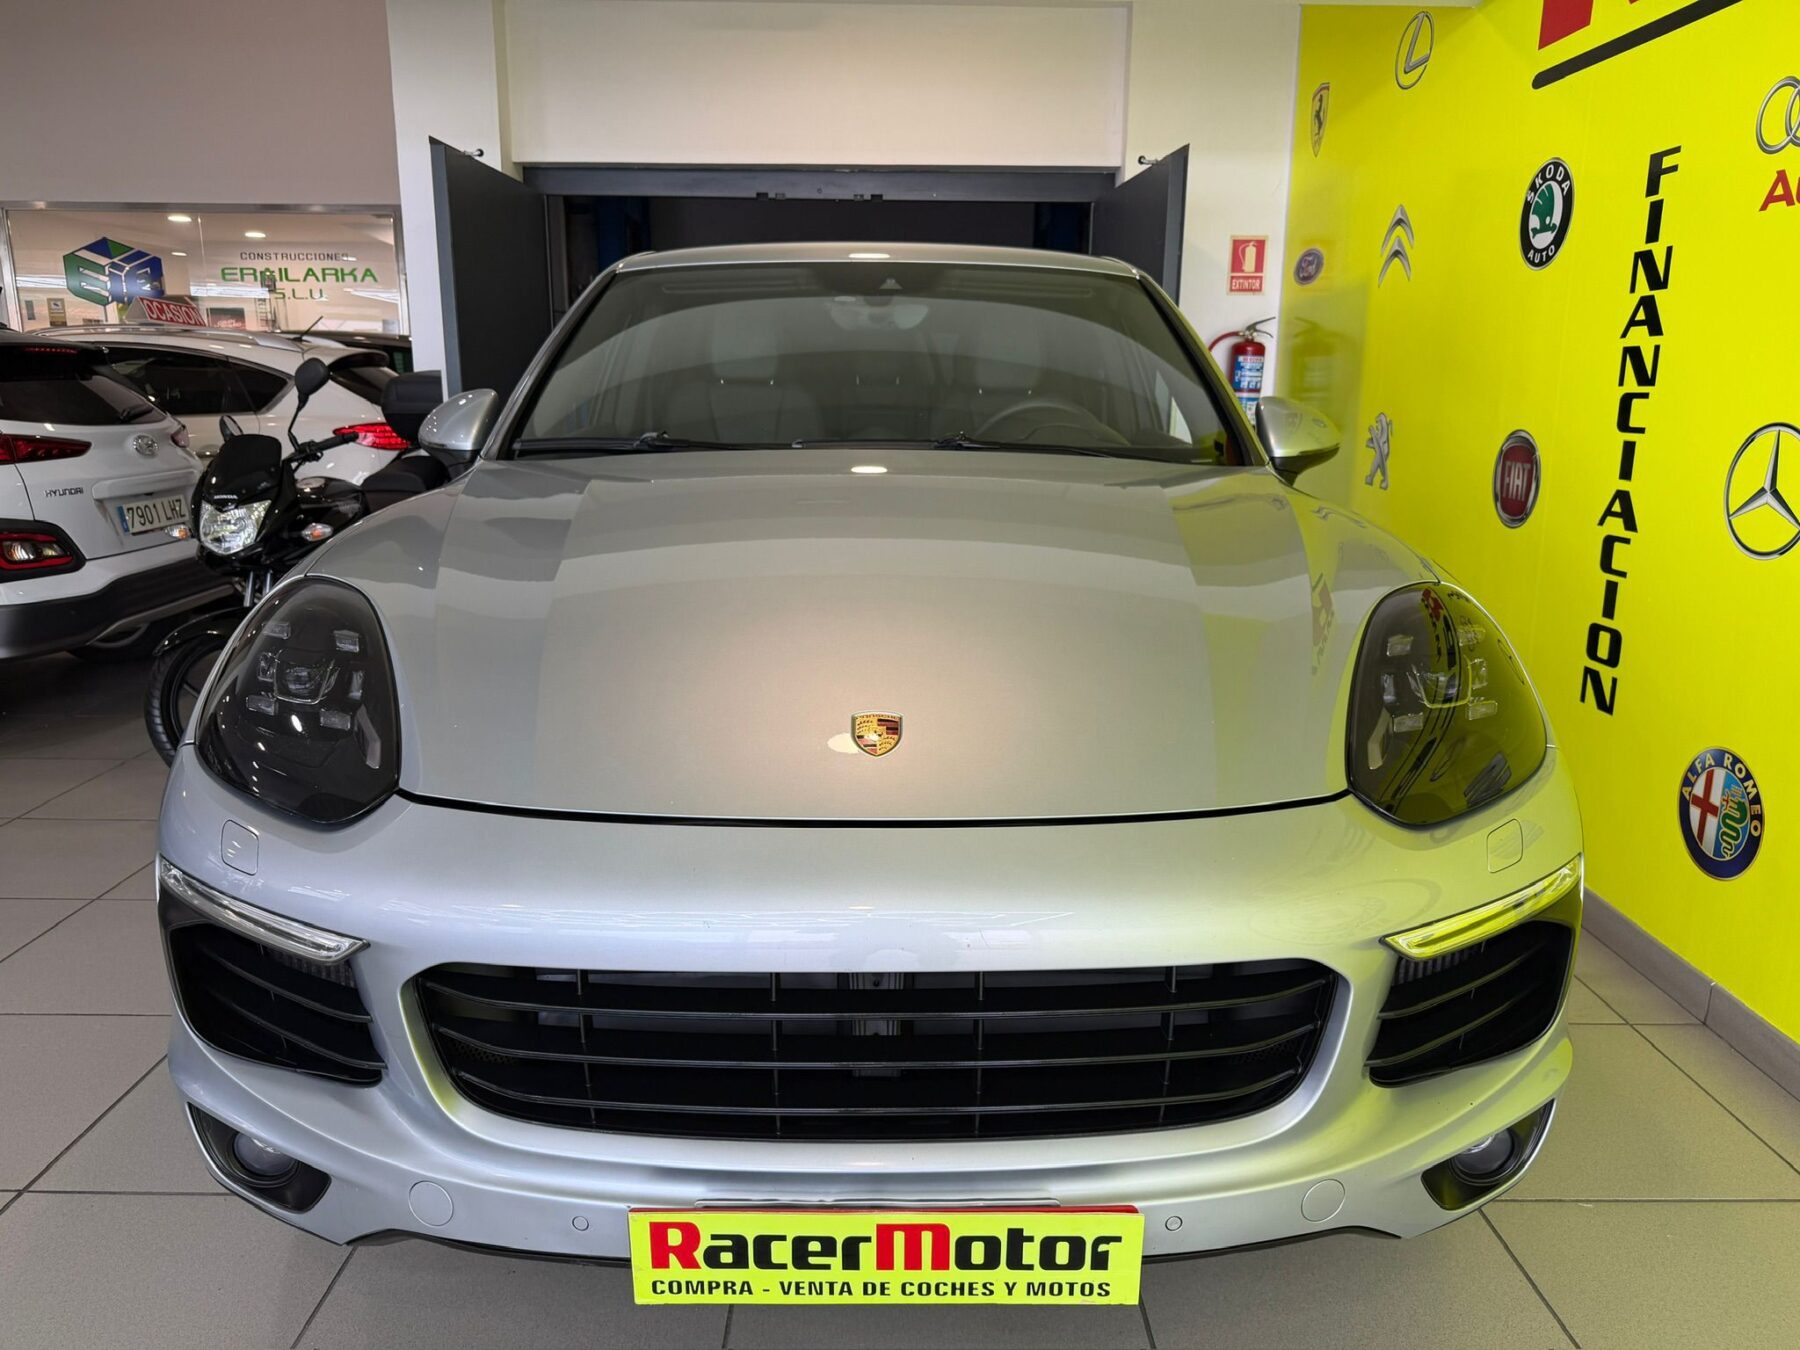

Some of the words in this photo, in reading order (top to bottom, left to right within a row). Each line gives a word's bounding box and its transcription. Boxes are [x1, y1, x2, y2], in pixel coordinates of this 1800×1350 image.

[1759, 169, 1800, 212] A
[1527, 245, 1556, 263] AUTO
[1231, 278, 1262, 291] EXTINTOR
[143, 299, 206, 326] OCASION
[1579, 145, 1682, 716] FINANCIACION
[45, 487, 84, 498] HYUNDAI
[1503, 461, 1532, 501] FIAT
[126, 503, 161, 529] 7901
[161, 498, 186, 521] LHZ
[1681, 753, 1716, 801] ALFA
[1723, 752, 1762, 838] ROMEO
[649, 1221, 1122, 1271] RacerMotor
[651, 1279, 754, 1296] COMPRA
[779, 1280, 854, 1297] VENTA
[862, 1281, 891, 1297] DE
[901, 1281, 995, 1297] COCHES
[1004, 1281, 1018, 1297] Y
[1026, 1281, 1111, 1297] MOTOS
